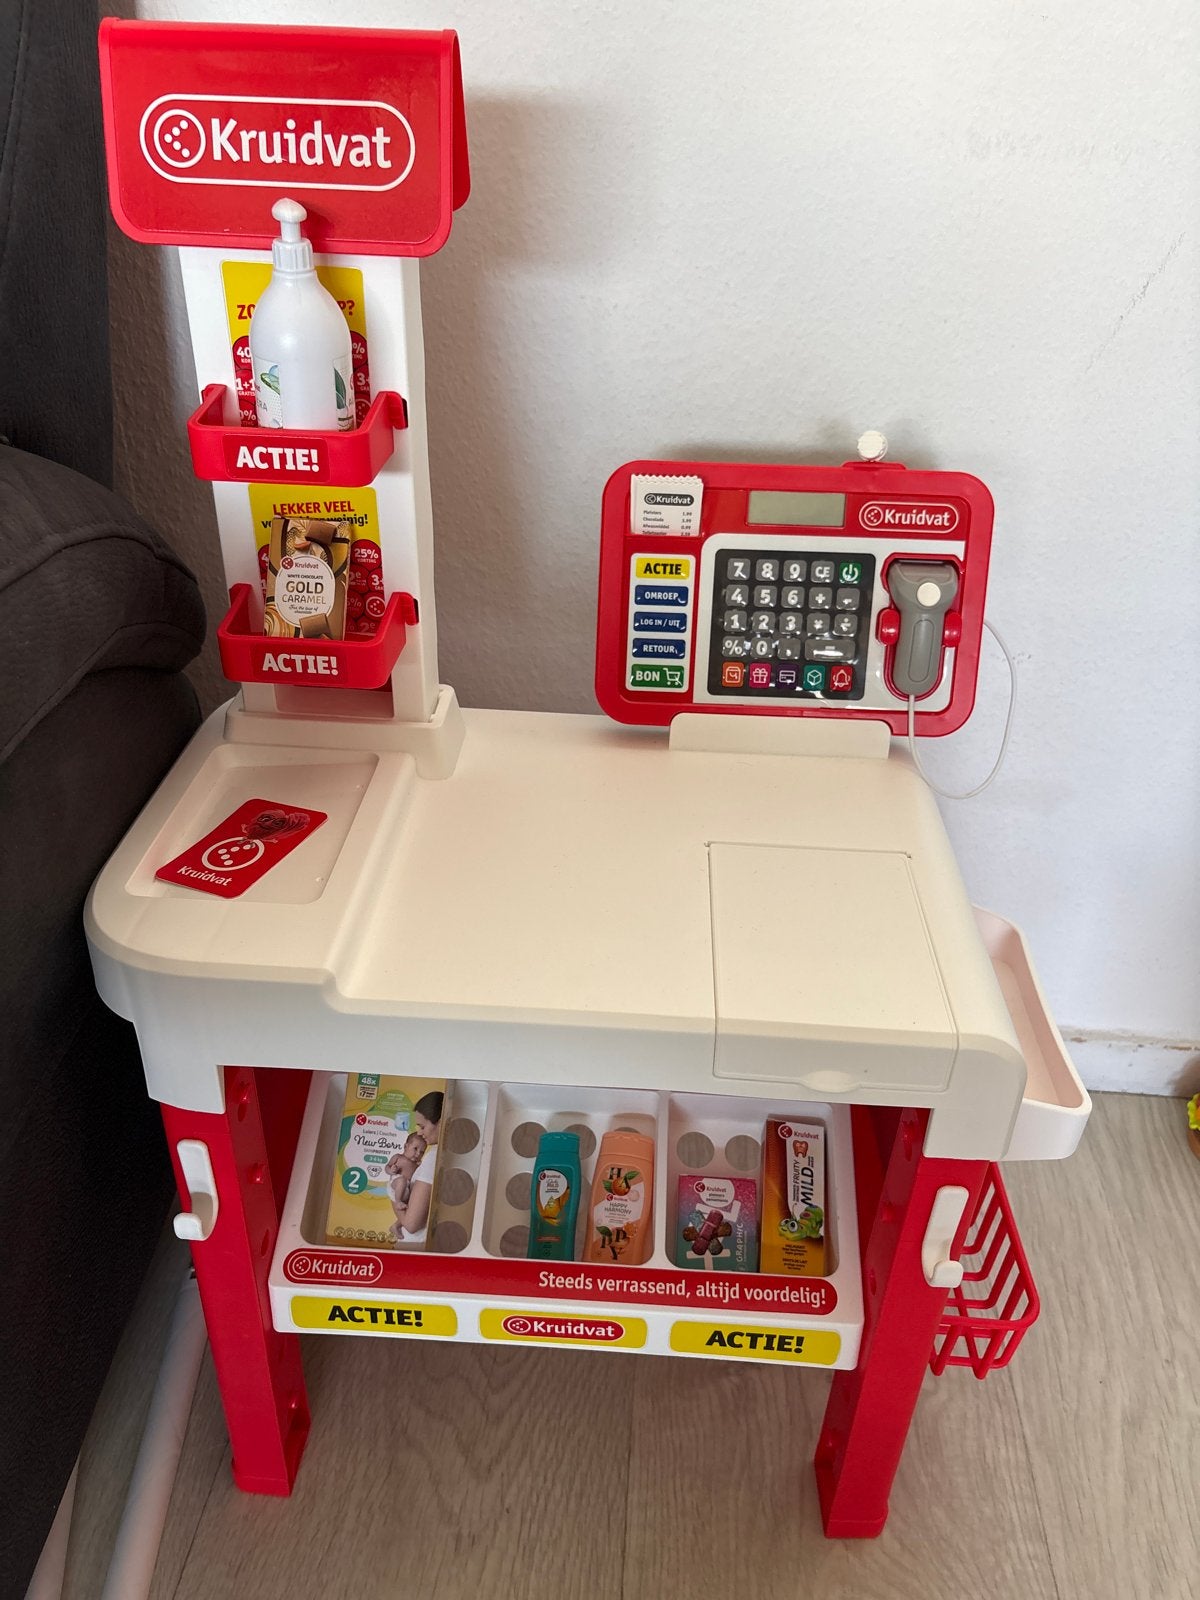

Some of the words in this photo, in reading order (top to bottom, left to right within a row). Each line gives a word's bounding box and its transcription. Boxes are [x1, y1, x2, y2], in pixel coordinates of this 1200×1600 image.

[210, 117, 392, 169] Kruidvat
[236, 446, 320, 473] ACTIE!
[656, 495, 691, 505] Kruidvat
[273, 502, 321, 516] LEKKER
[324, 501, 355, 513] VEEL
[884, 509, 950, 526] Kruidvat
[354, 548, 379, 559] 25%
[643, 562, 682, 575] ACTIE
[733, 562, 745, 577] 7
[761, 563, 773, 578] 8
[789, 563, 800, 579] 9
[815, 566, 830, 578] CE
[286, 581, 324, 594] GOLD
[282, 594, 326, 605] CARAMEL
[644, 591, 679, 600] OMROEP
[731, 588, 742, 603] 4
[760, 589, 771, 604] 5
[787, 590, 798, 605] 6
[640, 618, 653, 626] LOG
[668, 620, 680, 628] UIT
[730, 614, 740, 629] 1
[758, 615, 769, 630] 2
[785, 616, 796, 631] 3
[643, 644, 675, 653] RETOUR
[725, 640, 743, 655] %
[756, 641, 768, 655] 0
[262, 653, 338, 676] ACTIE!
[635, 670, 660, 682] BON
[177, 866, 233, 887] Kruidvat
[354, 1135, 378, 1147] New
[377, 1138, 402, 1150] Born
[794, 1131, 819, 1140] Kruidvat
[348, 1171, 360, 1188] 2
[801, 1167, 814, 1206] MILD
[736, 1223, 744, 1262] GRAPHIC
[311, 1258, 375, 1277] Kruidvat
[539, 1271, 593, 1291] Steeds
[597, 1277, 691, 1298] verrassend,
[696, 1281, 740, 1303] altijd
[744, 1286, 826, 1309] voordelig!
[328, 1305, 423, 1327] ACTIE!
[533, 1320, 615, 1338] Kruidvat
[706, 1331, 805, 1354] ACTIE!
